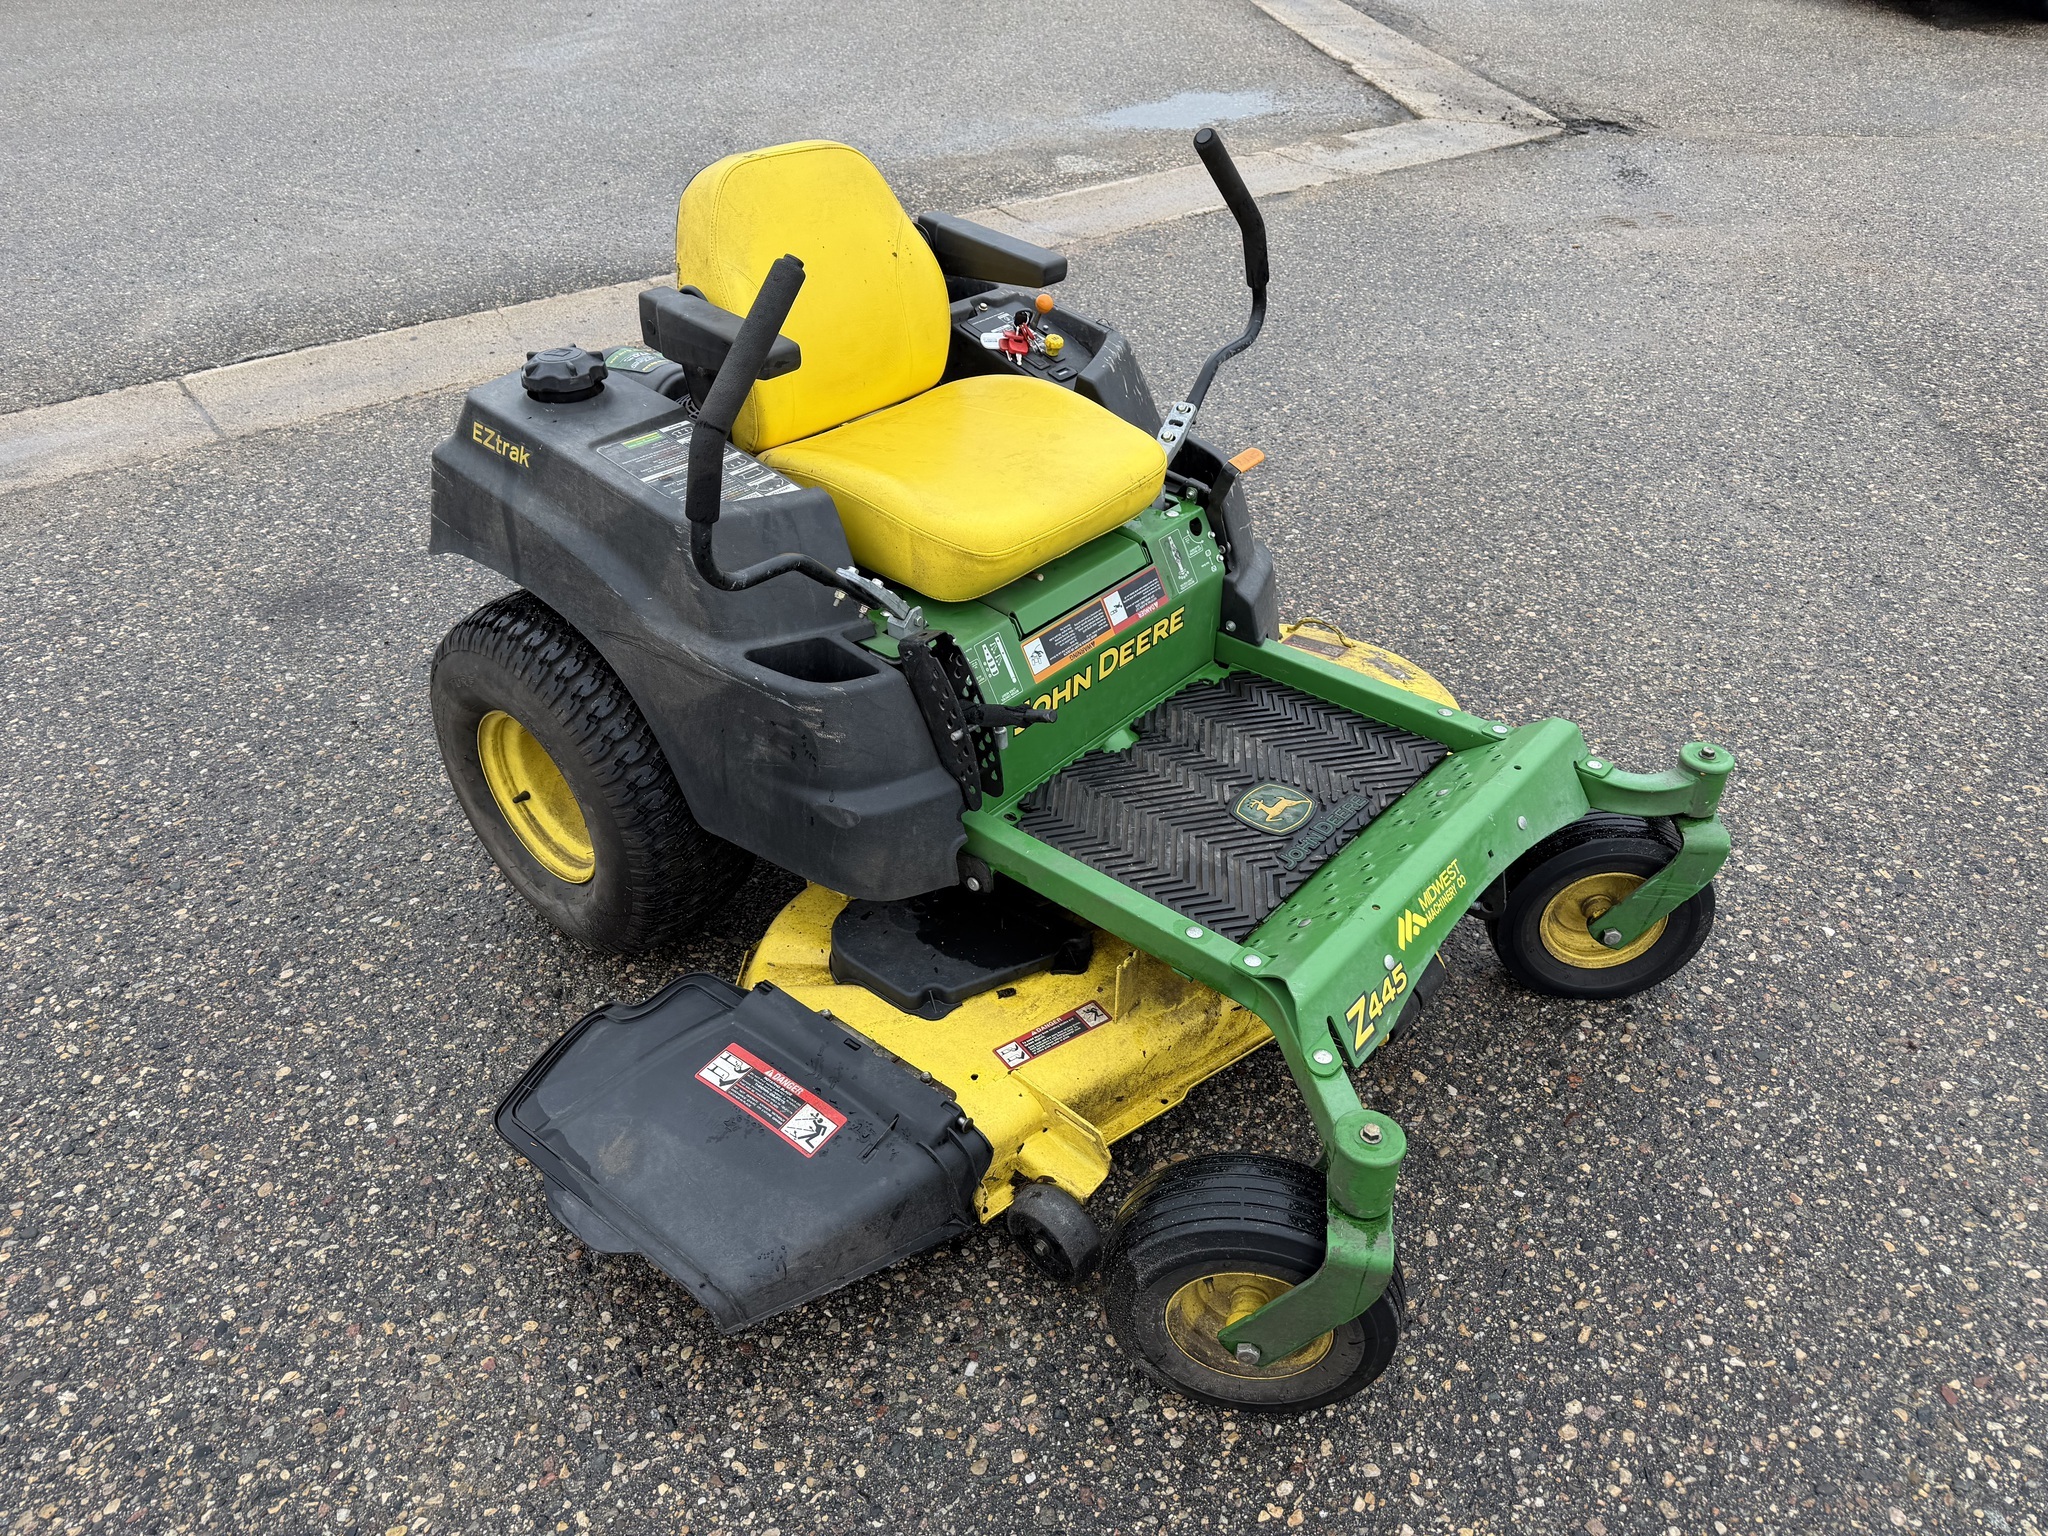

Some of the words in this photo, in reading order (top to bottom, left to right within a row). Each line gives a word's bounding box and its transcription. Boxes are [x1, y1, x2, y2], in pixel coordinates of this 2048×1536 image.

[472, 421, 531, 468] EZtrak
[1099, 605, 1186, 681] DEERE
[1279, 830, 1327, 870] JOHN
[1313, 795, 1369, 836] DEERE
[1418, 858, 1460, 911] MIDWEST
[1424, 883, 1458, 924] MACHINERY
[1035, 1017, 1063, 1033] DANGER
[1345, 962, 1409, 1052] Z445
[771, 1072, 804, 1095] DANGER
